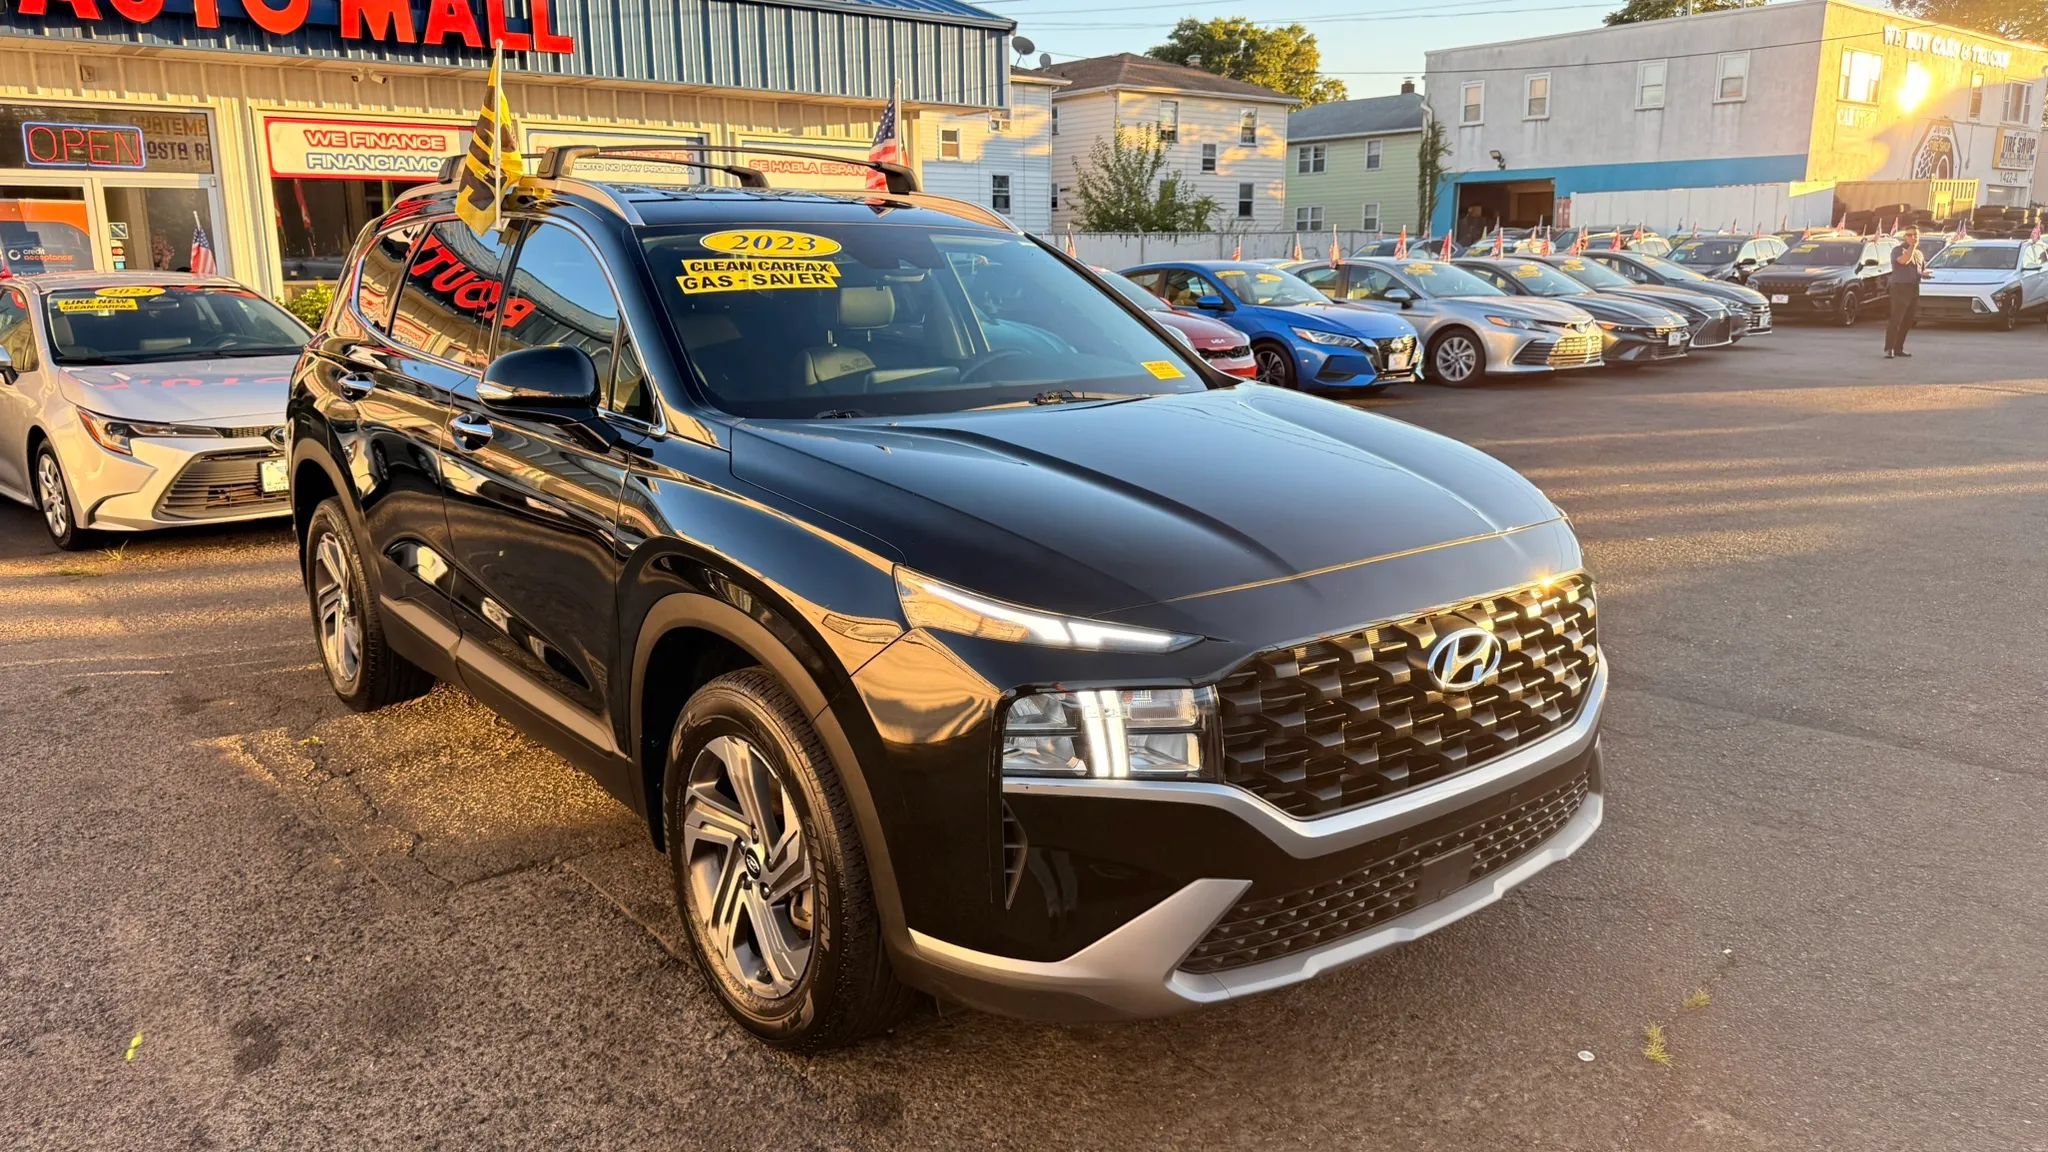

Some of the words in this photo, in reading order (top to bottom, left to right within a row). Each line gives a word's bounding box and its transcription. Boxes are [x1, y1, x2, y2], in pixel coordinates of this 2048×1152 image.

[340, 0, 576, 54] MALL
[28, 126, 141, 165] OPEN
[304, 130, 347, 147] WE
[350, 132, 446, 151] FINANCE
[2003, 136, 2017, 152] TIRE
[2017, 137, 2036, 154] SHOP
[145, 141, 189, 161] OSTA
[306, 153, 445, 172] FINANCIAMO
[605, 163, 620, 172] NO
[749, 160, 769, 173] SE
[771, 160, 819, 175] HABLA
[23, 247, 45, 255] credit
[730, 235, 816, 251] 2023
[690, 261, 753, 272] CLEAN
[757, 261, 830, 273] CARFAX
[683, 275, 734, 290] GAS
[753, 273, 829, 286] SAVER
